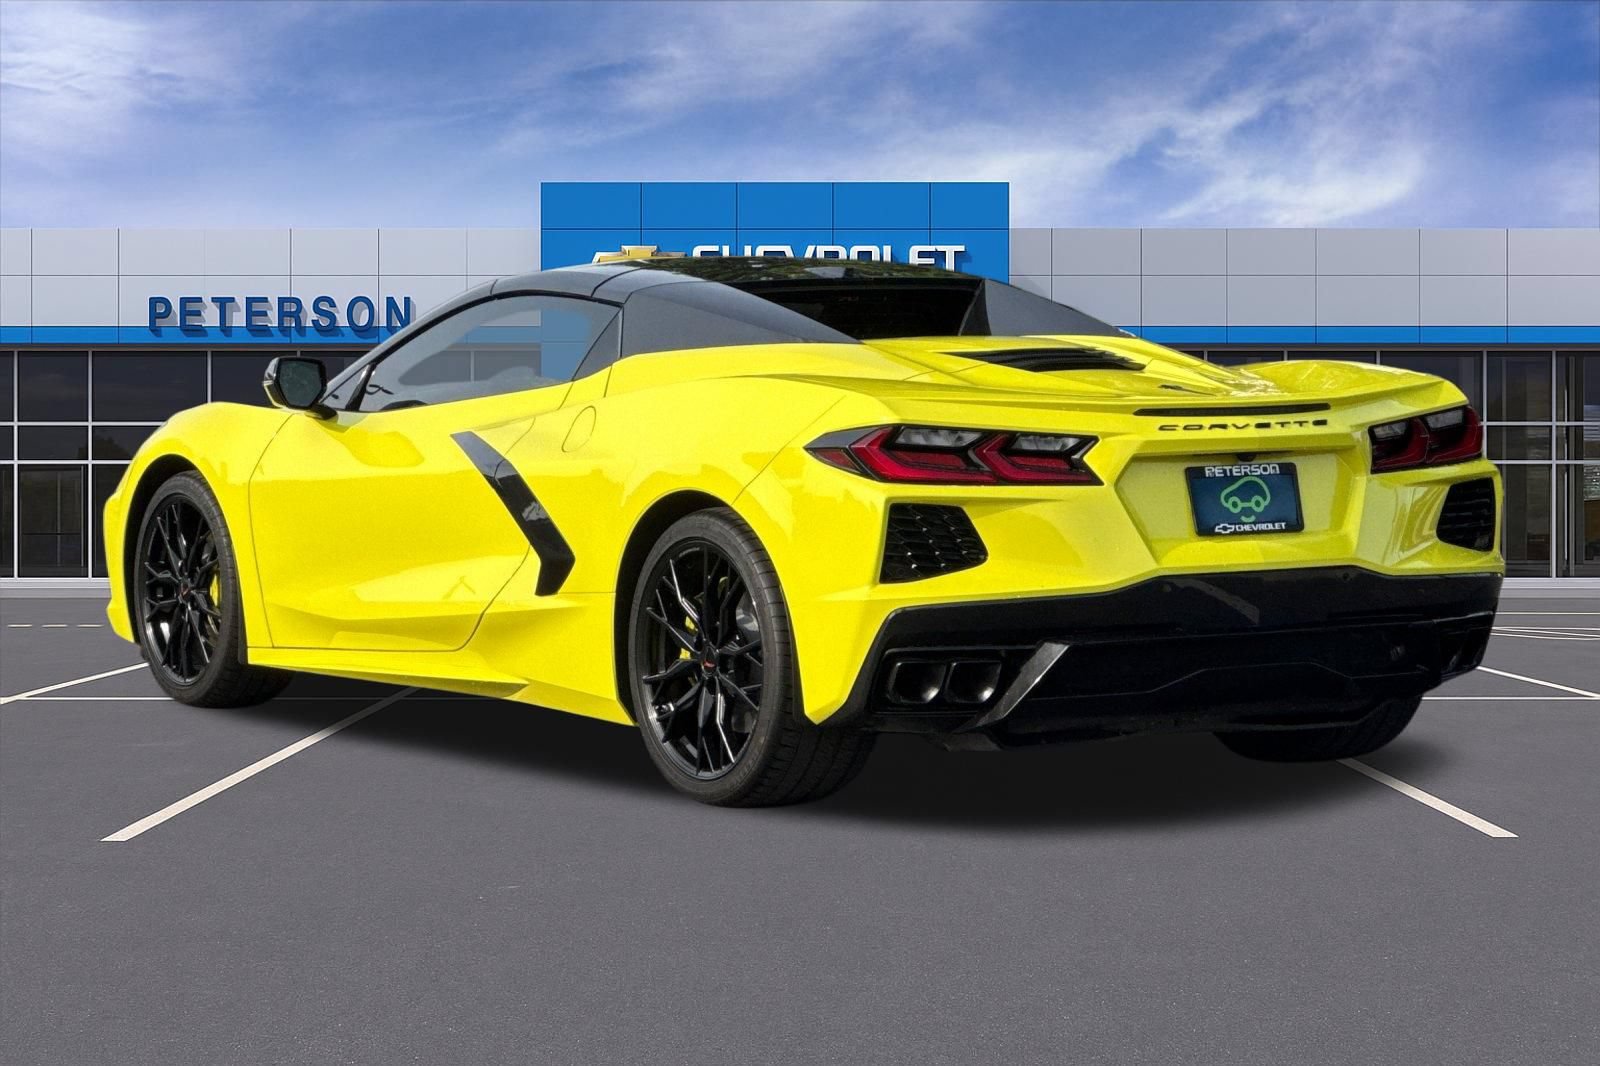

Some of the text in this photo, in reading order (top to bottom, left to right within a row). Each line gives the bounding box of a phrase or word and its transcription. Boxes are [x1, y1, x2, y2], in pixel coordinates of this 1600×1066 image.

[148, 296, 411, 331] PETERSON
[1158, 419, 1328, 431] CORVETTE
[1205, 464, 1280, 477] PETERSON
[1236, 522, 1286, 532] CHEVROLET
